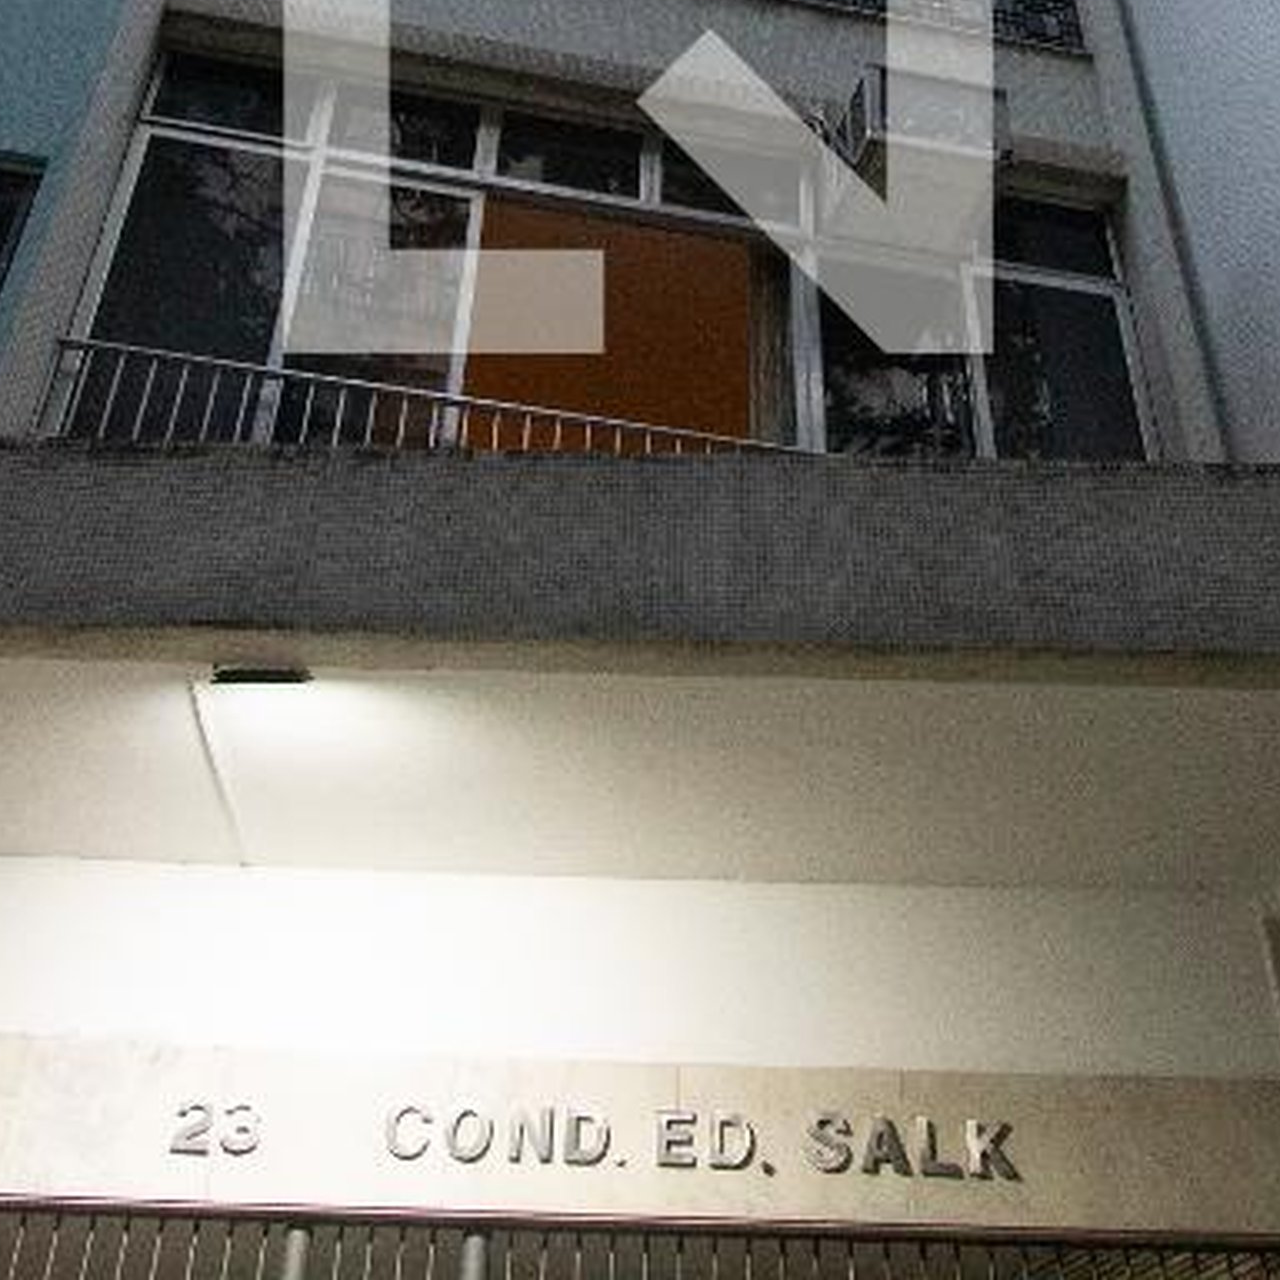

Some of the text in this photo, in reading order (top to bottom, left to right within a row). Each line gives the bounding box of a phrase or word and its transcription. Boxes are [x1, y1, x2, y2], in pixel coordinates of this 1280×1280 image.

[168, 1103, 1023, 1183] 23 COND. ED. SALK
